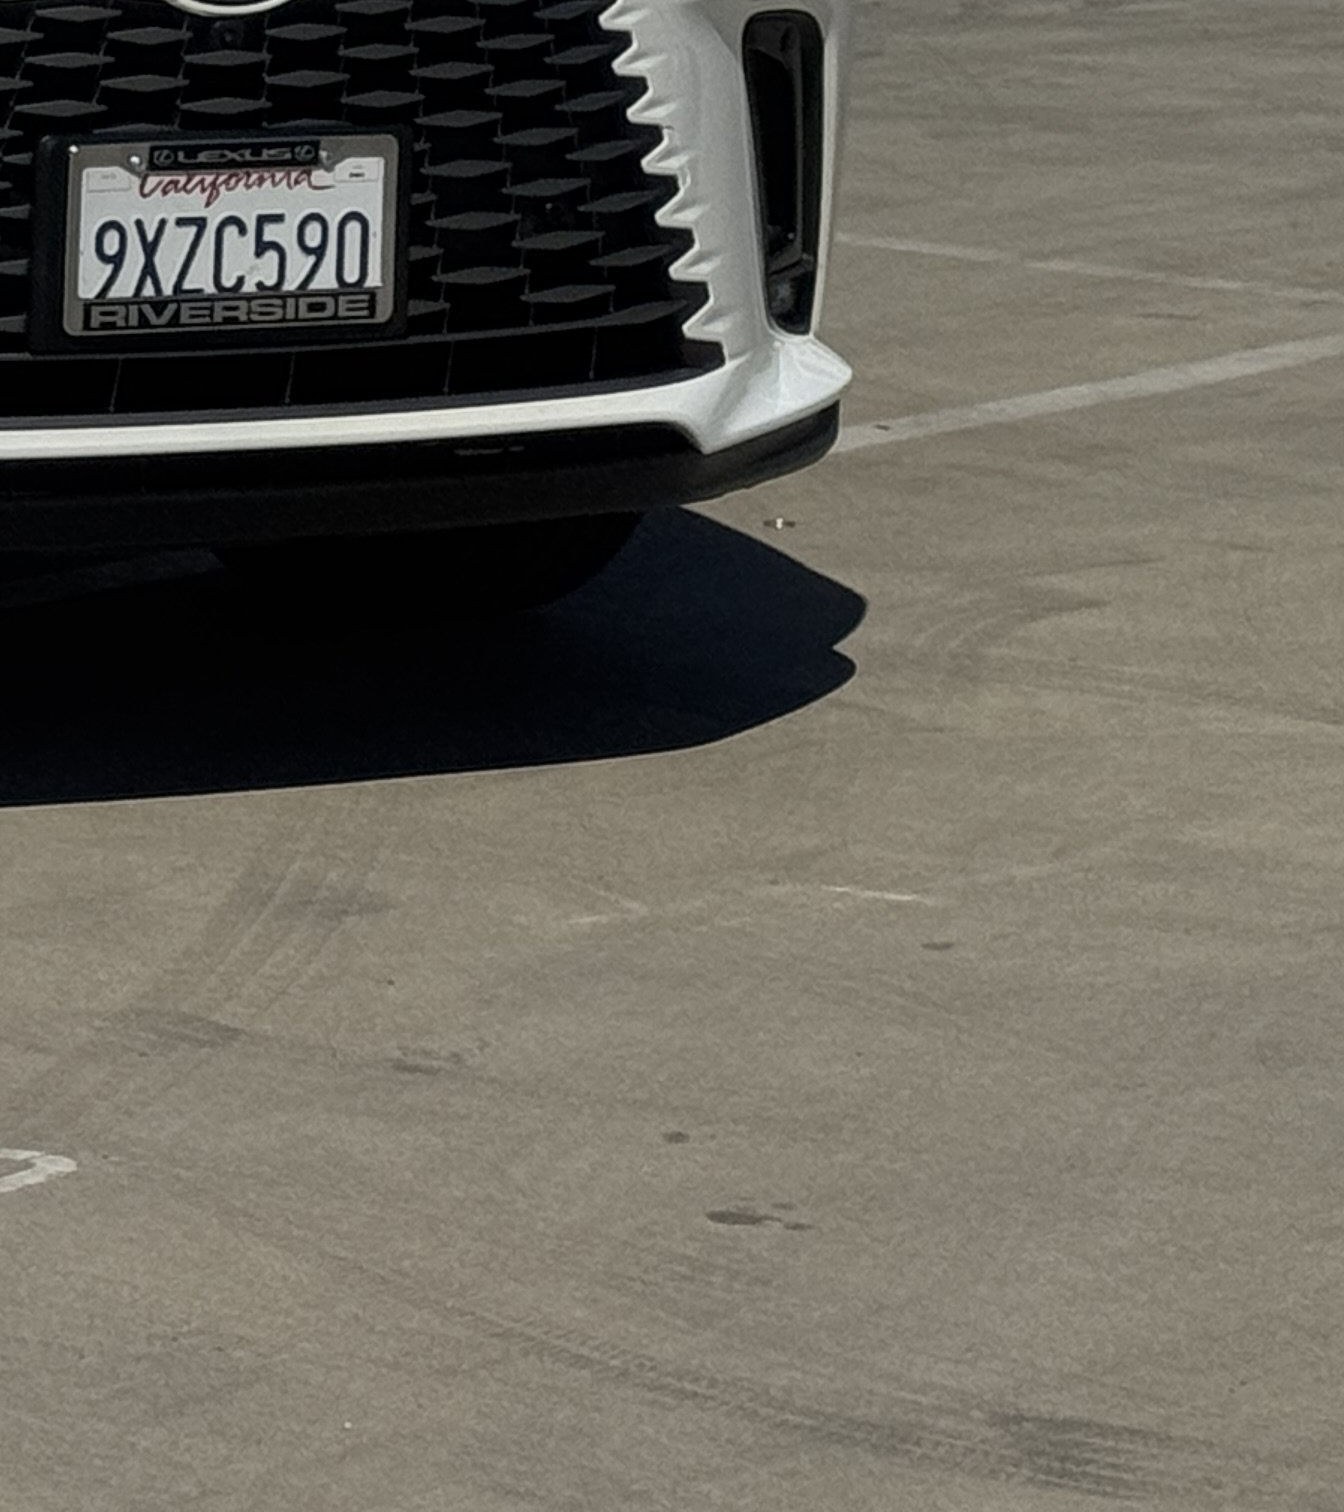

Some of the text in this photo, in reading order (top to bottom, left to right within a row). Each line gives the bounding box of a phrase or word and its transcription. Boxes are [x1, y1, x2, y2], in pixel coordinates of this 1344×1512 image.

[176, 147, 293, 164] LEXUS
[139, 169, 335, 208] California
[94, 210, 370, 299] 9XZC590
[89, 294, 371, 330] RIVERSIDE
